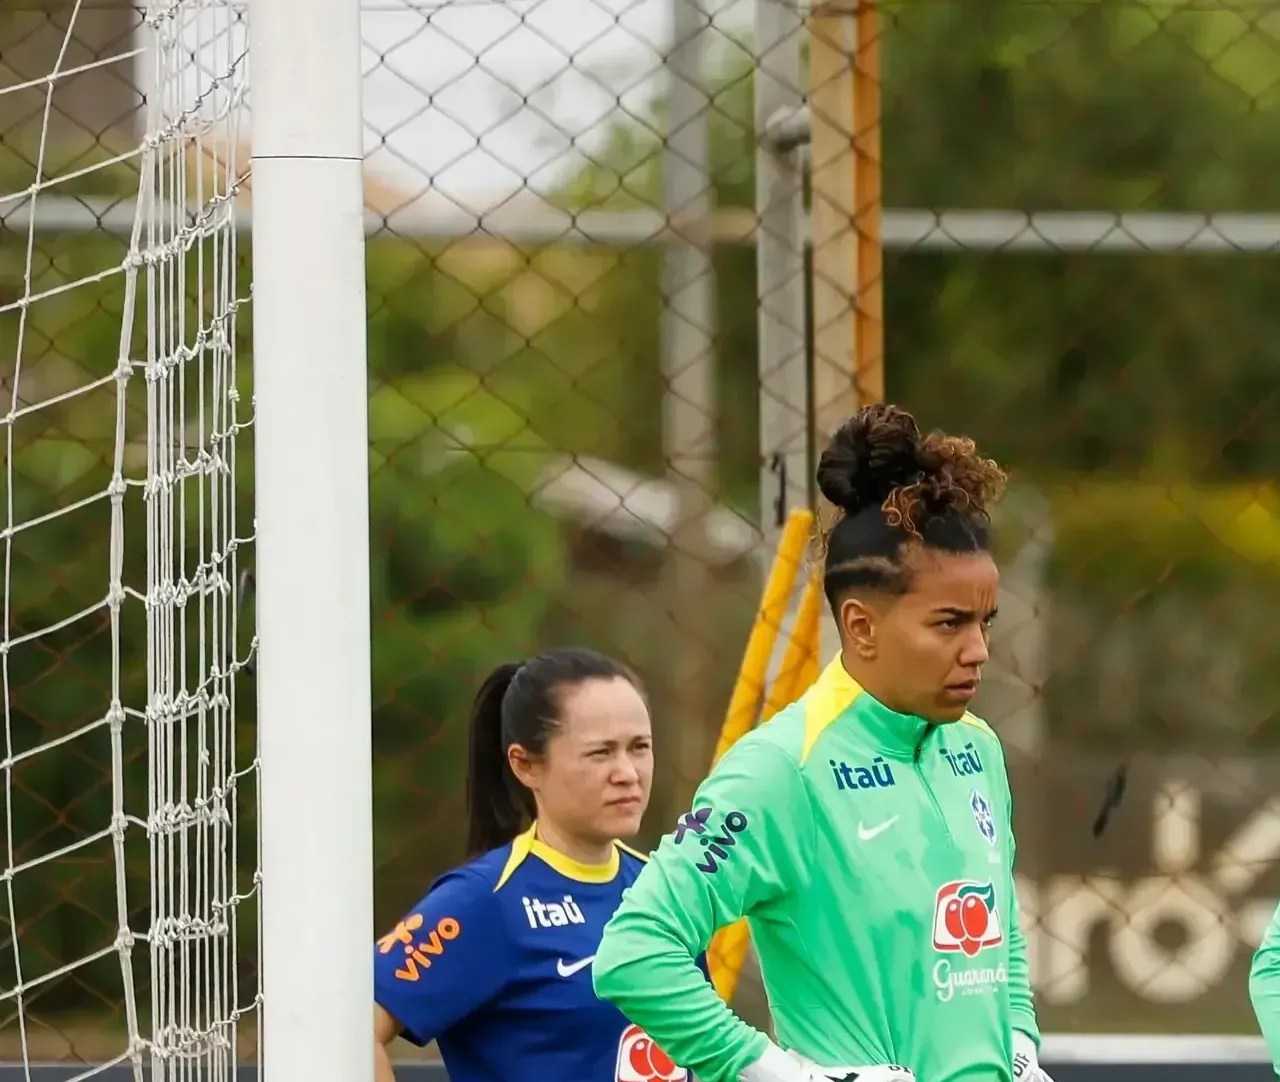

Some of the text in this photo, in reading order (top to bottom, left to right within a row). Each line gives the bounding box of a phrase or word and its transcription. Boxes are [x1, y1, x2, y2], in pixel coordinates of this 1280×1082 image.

[829, 757, 896, 790] itaú
[940, 743, 983, 777] itaú
[696, 811, 748, 874] vivo
[522, 895, 585, 928] itaú
[395, 917, 461, 982] vivo
